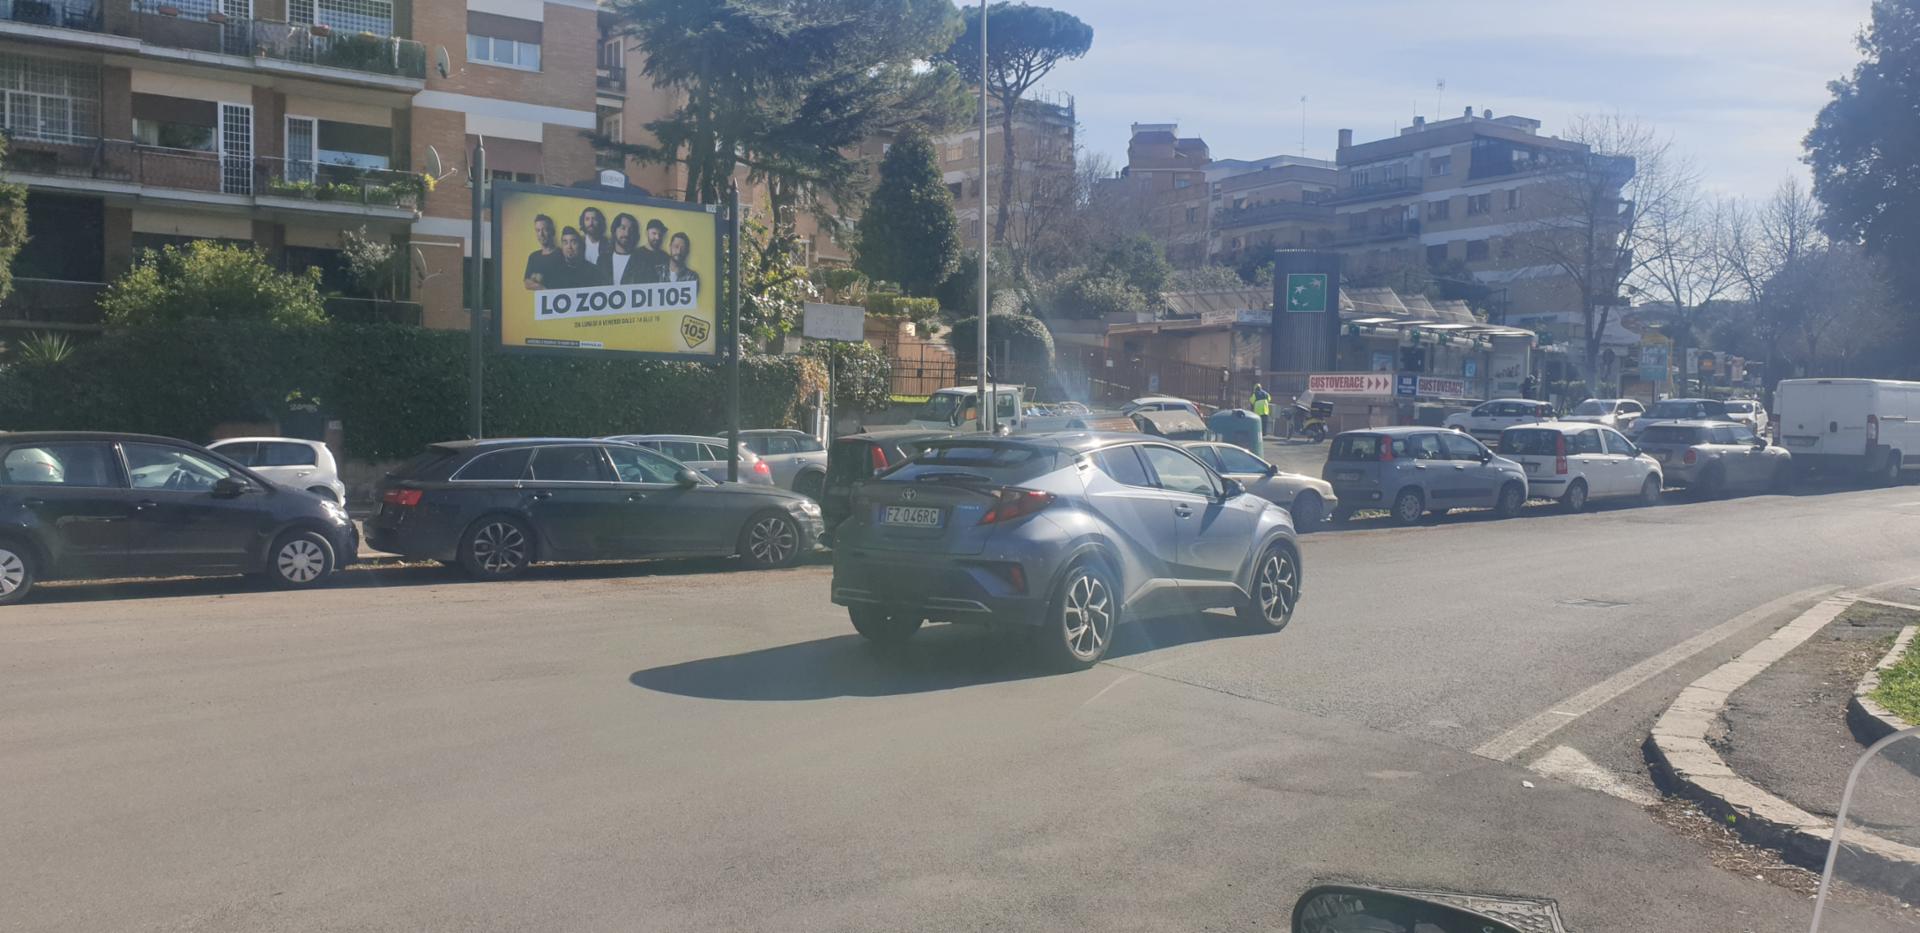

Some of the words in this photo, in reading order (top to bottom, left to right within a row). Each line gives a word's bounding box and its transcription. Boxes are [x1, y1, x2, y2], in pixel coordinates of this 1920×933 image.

[541, 294, 572, 315] LO
[576, 289, 626, 313] ZOO
[631, 288, 652, 308] DI
[658, 287, 692, 306] 105
[684, 323, 706, 340] 105
[1311, 376, 1364, 389] GUSTOVERACE
[887, 507, 900, 521] FZ
[903, 508, 937, 523] 046RG
